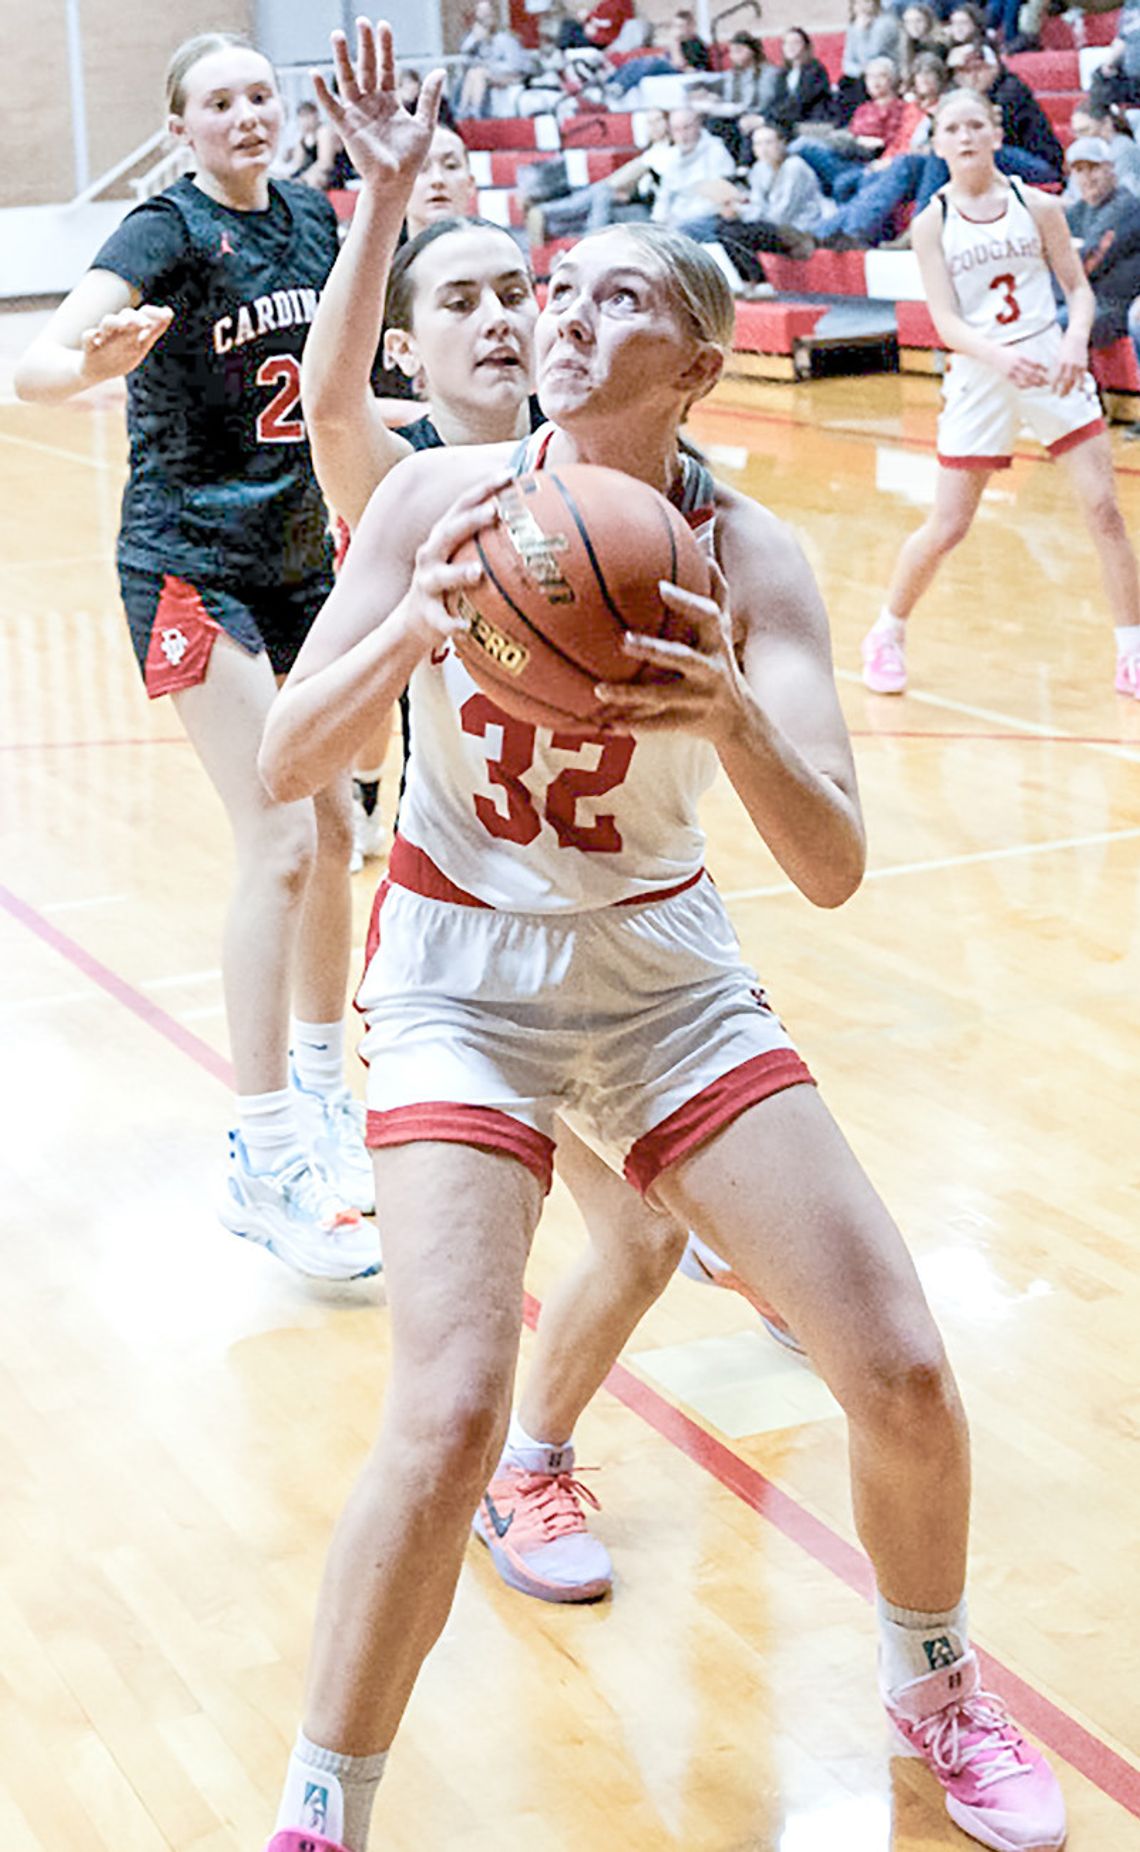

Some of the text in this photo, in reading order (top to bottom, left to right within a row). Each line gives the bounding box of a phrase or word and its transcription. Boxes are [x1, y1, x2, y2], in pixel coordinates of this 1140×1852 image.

[989, 272, 1021, 325] 3
[256, 354, 305, 443] 2
[460, 692, 637, 853] 32
